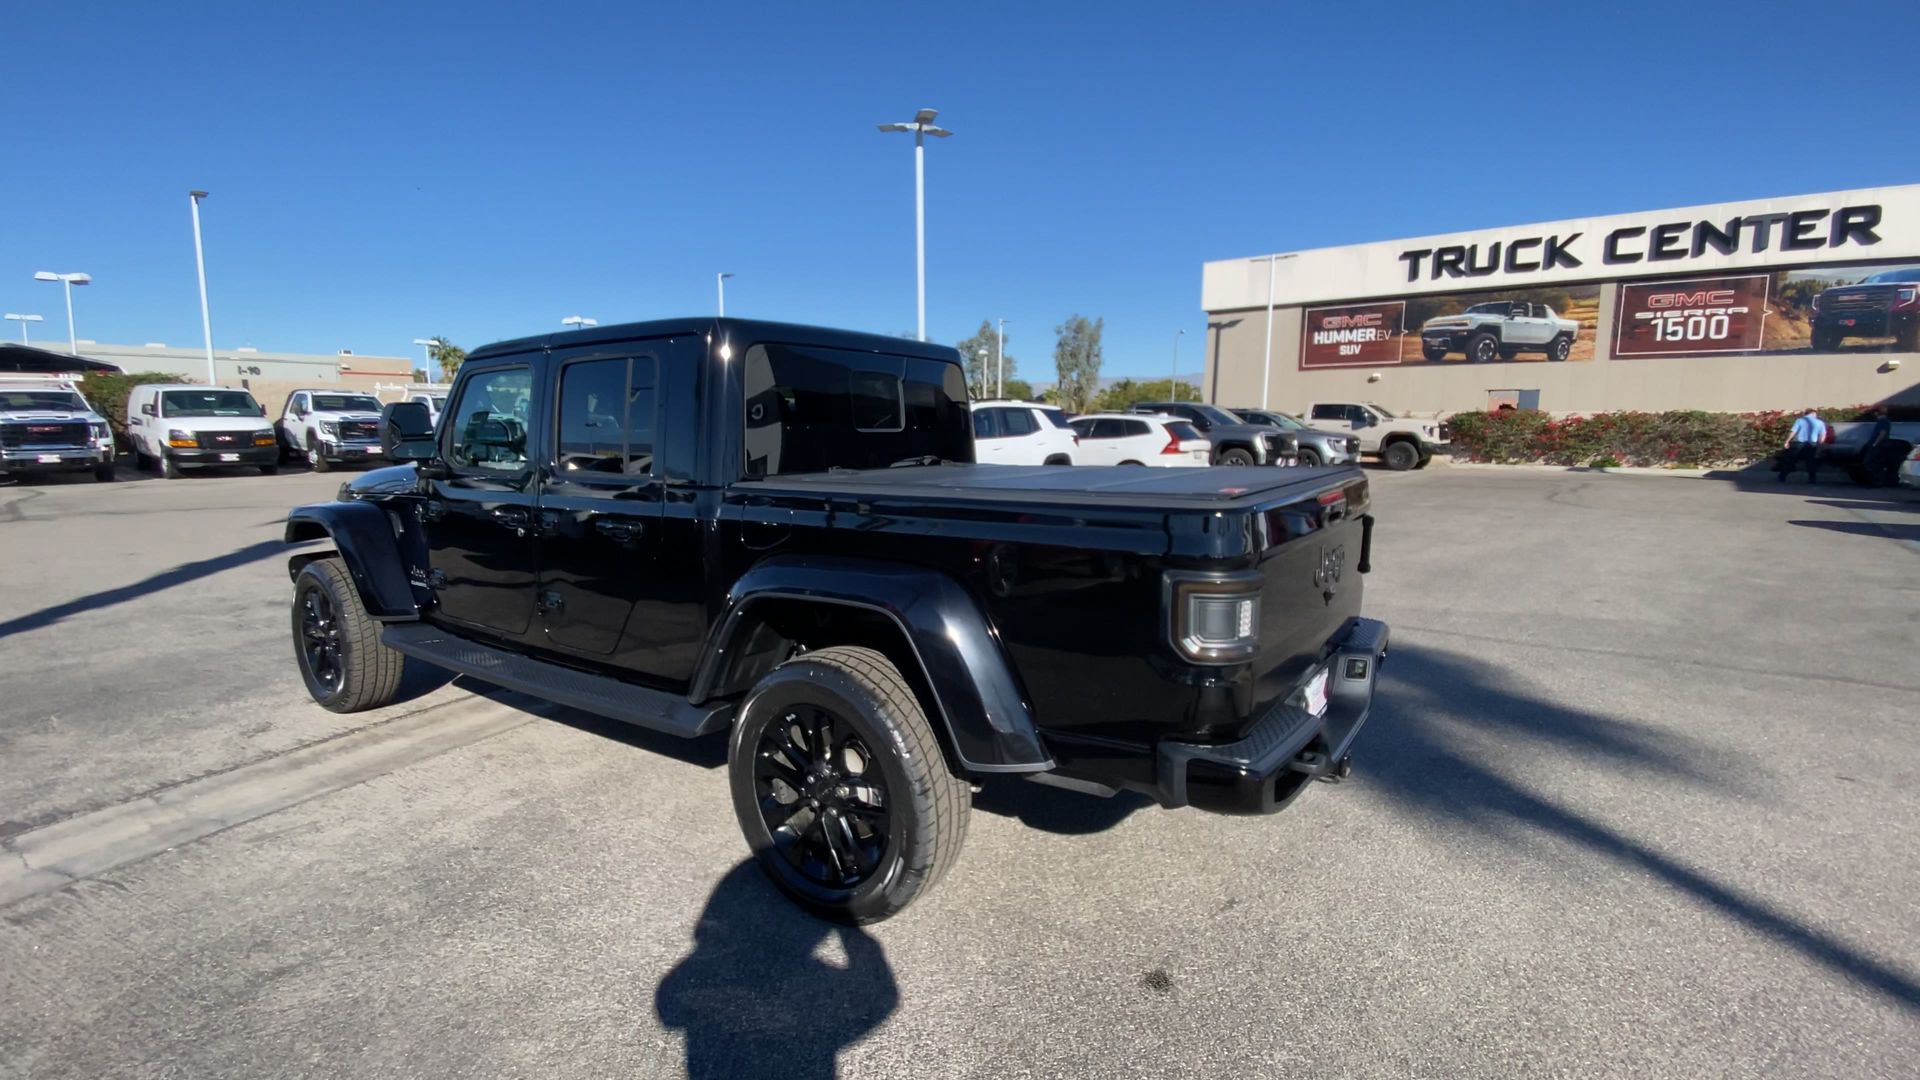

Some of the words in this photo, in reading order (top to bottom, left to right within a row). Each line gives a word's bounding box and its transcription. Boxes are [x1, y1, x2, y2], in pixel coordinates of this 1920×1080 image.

[1399, 232, 1584, 282] TRUCK
[1603, 204, 1882, 266] CENTER
[1648, 290, 1735, 308] GMC
[1323, 313, 1383, 329] GMC
[1635, 307, 1748, 319] SIERRA
[1313, 327, 1376, 344] HUMMER
[1377, 329, 1392, 341] EV
[1650, 315, 1729, 341] 1500
[1339, 344, 1362, 355] SUV
